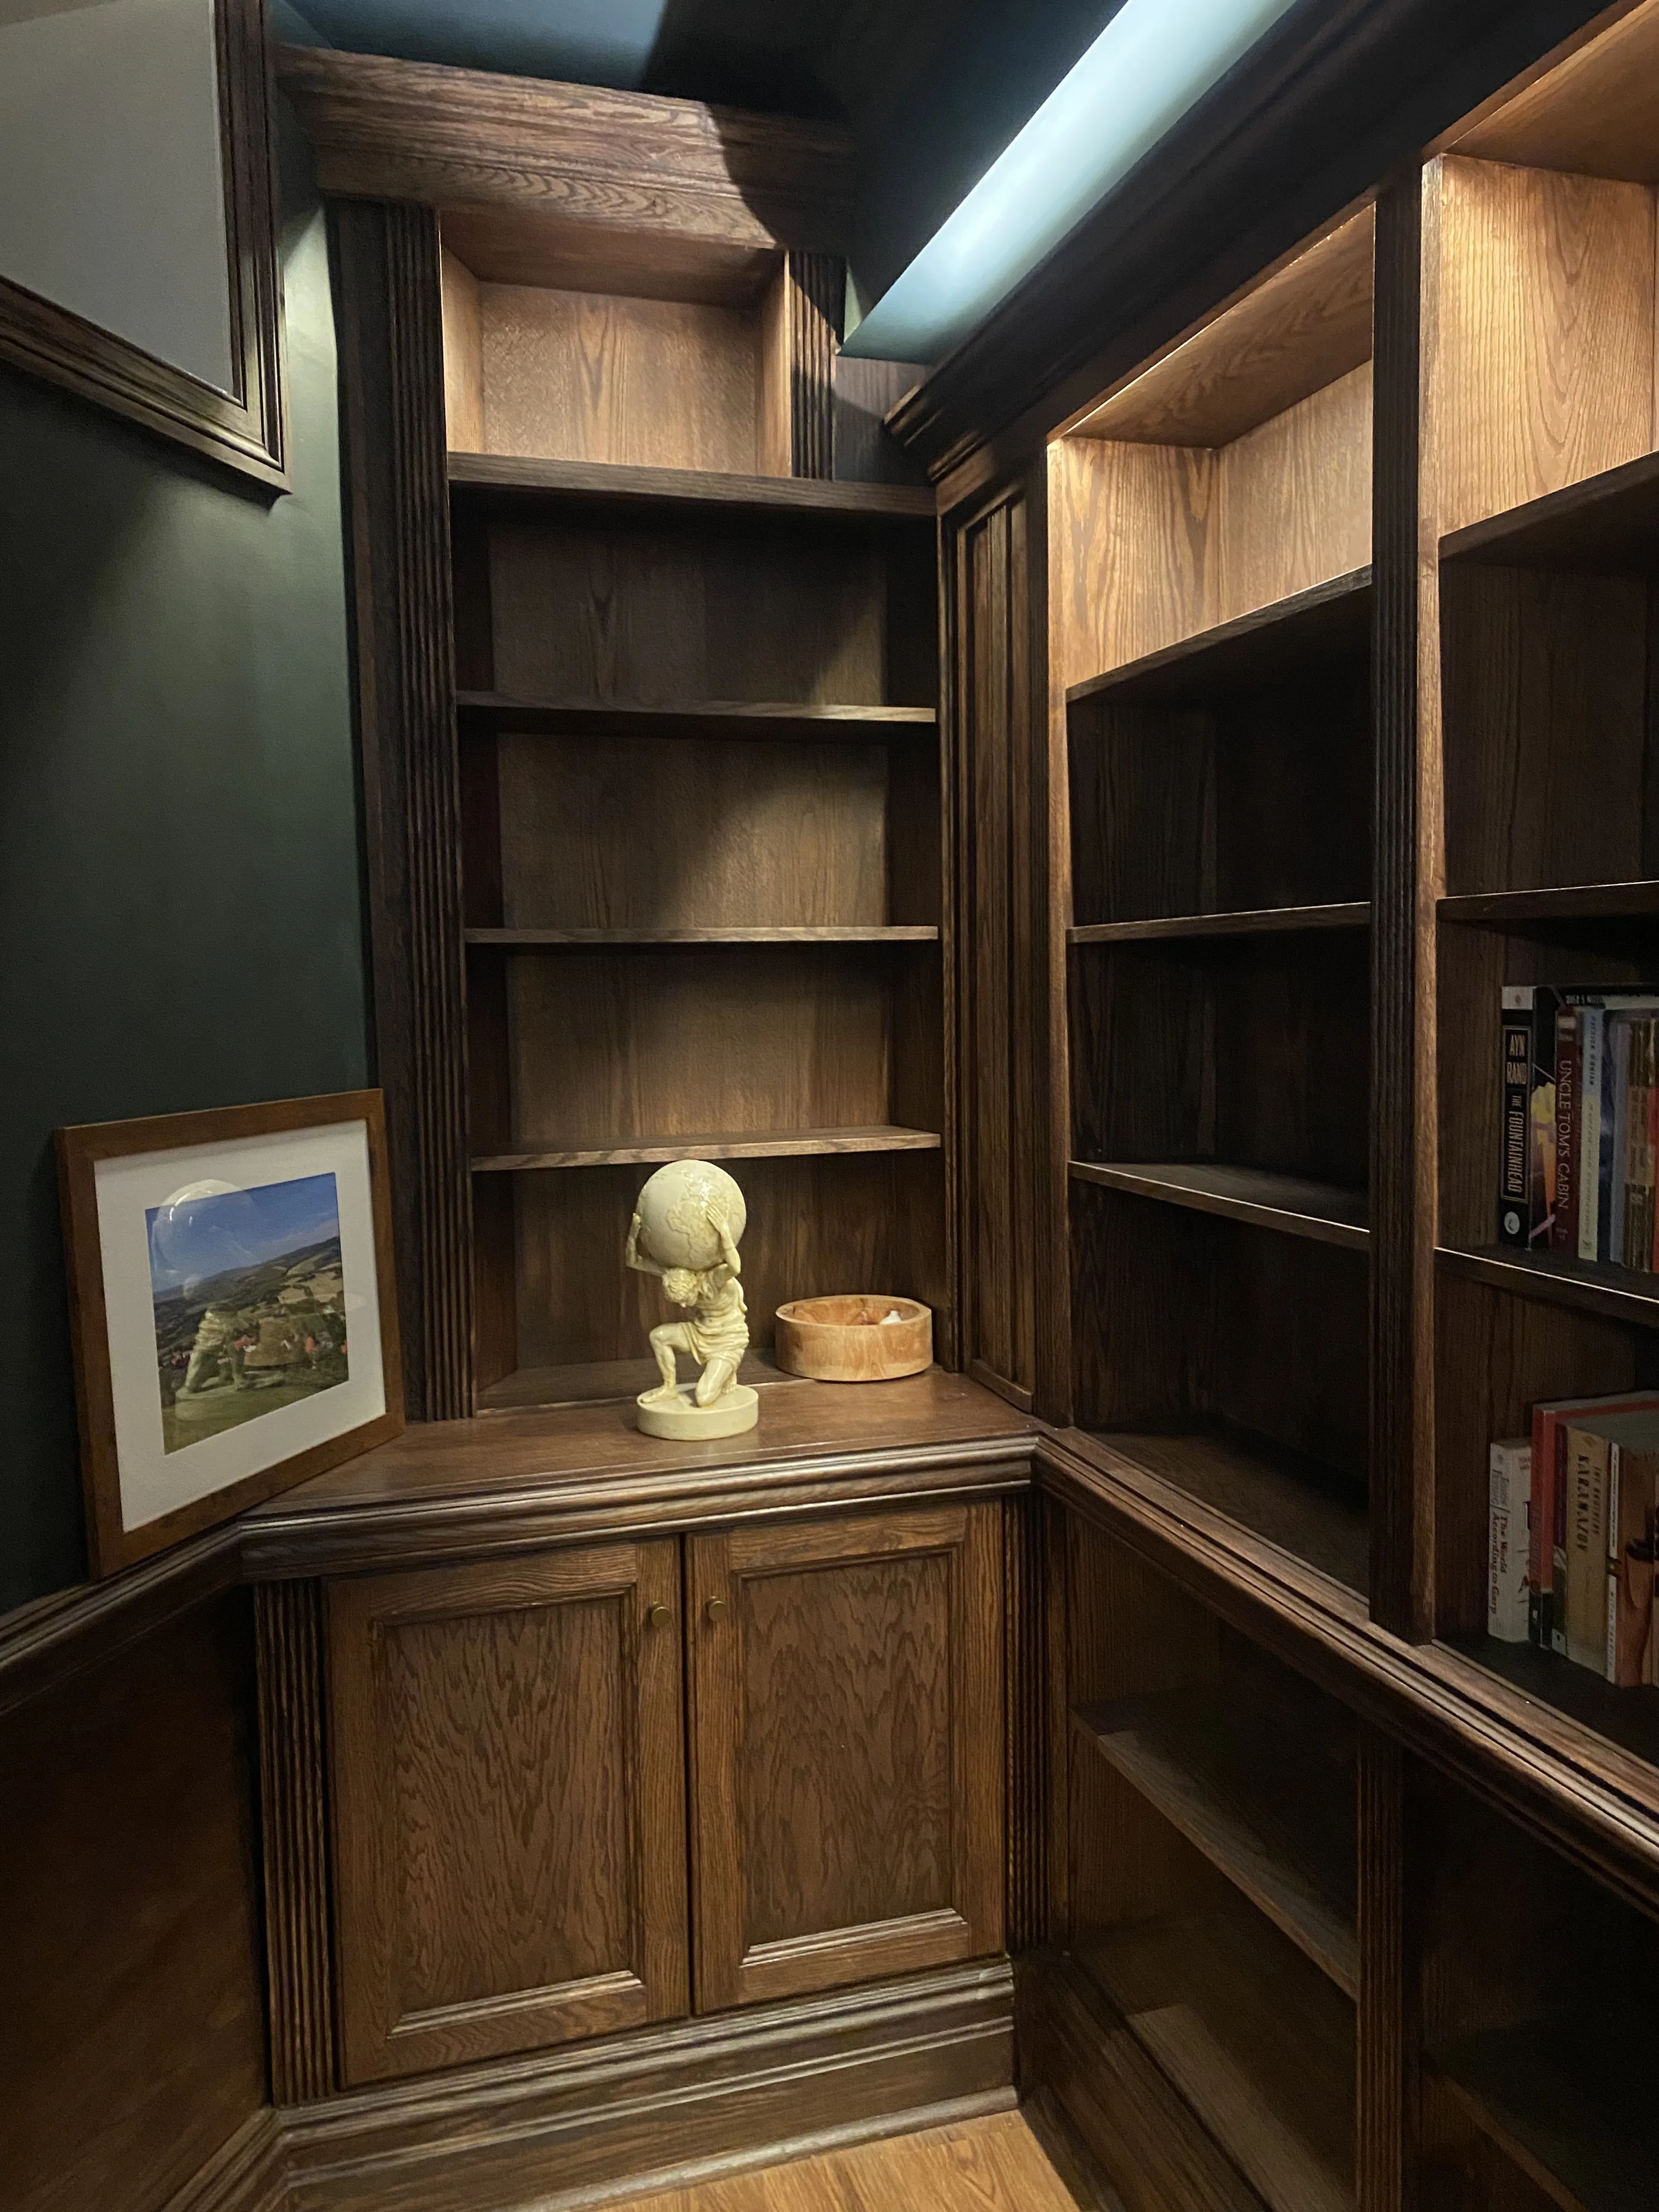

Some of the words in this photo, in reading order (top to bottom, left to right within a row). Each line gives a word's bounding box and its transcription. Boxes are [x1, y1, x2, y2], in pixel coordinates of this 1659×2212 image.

[1509, 1034, 1525, 1056] AYN
[1506, 1062, 1527, 1085] RAND
[1559, 1060, 1572, 1109] UNCLE
[1511, 1095, 1522, 1108] THE
[1508, 1111, 1523, 1193] FOUNTAINHEAD
[1558, 1111, 1571, 1158] TOM'S
[1558, 1163, 1570, 1208] CABIN
[1577, 1454, 1589, 1551] KARAMAZOV
[1491, 1512, 1500, 1570] According
[1499, 1515, 1508, 1536] The
[1492, 1572, 1498, 1583] to
[1489, 1585, 1499, 1614] Garp
